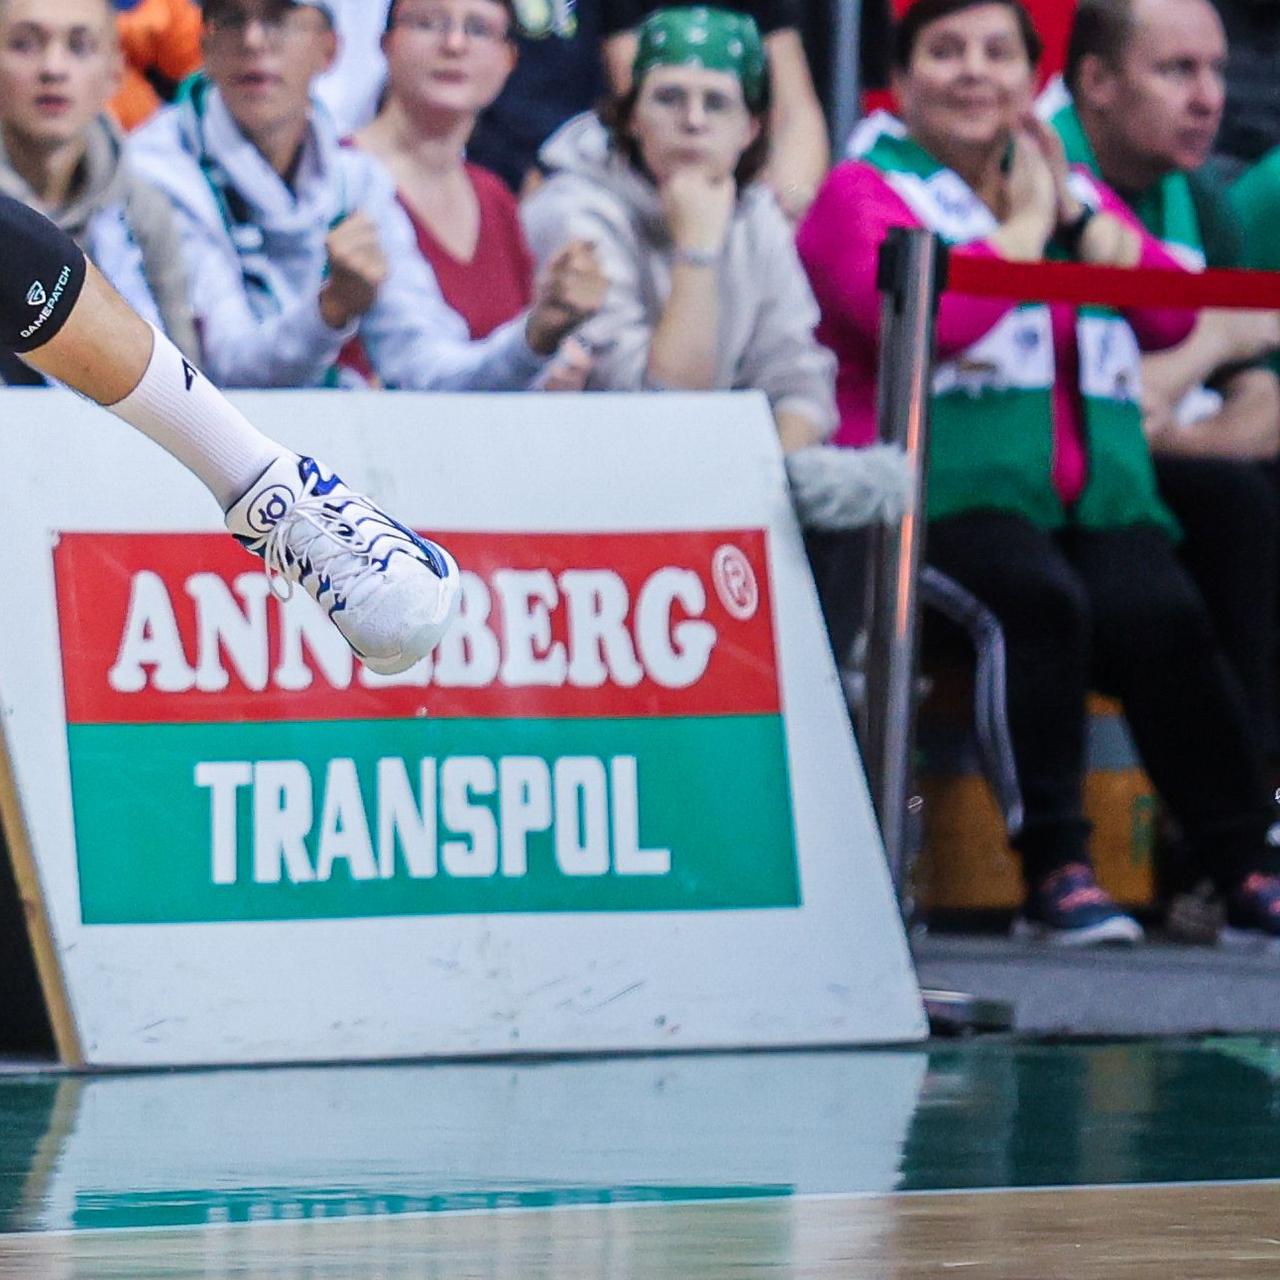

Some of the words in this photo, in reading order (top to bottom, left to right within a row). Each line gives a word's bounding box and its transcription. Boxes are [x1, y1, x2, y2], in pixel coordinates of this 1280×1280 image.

[20, 265, 72, 339] GAMEPATCH
[108, 566, 717, 692] ANNBERG
[194, 756, 671, 885] TRANSPOL
